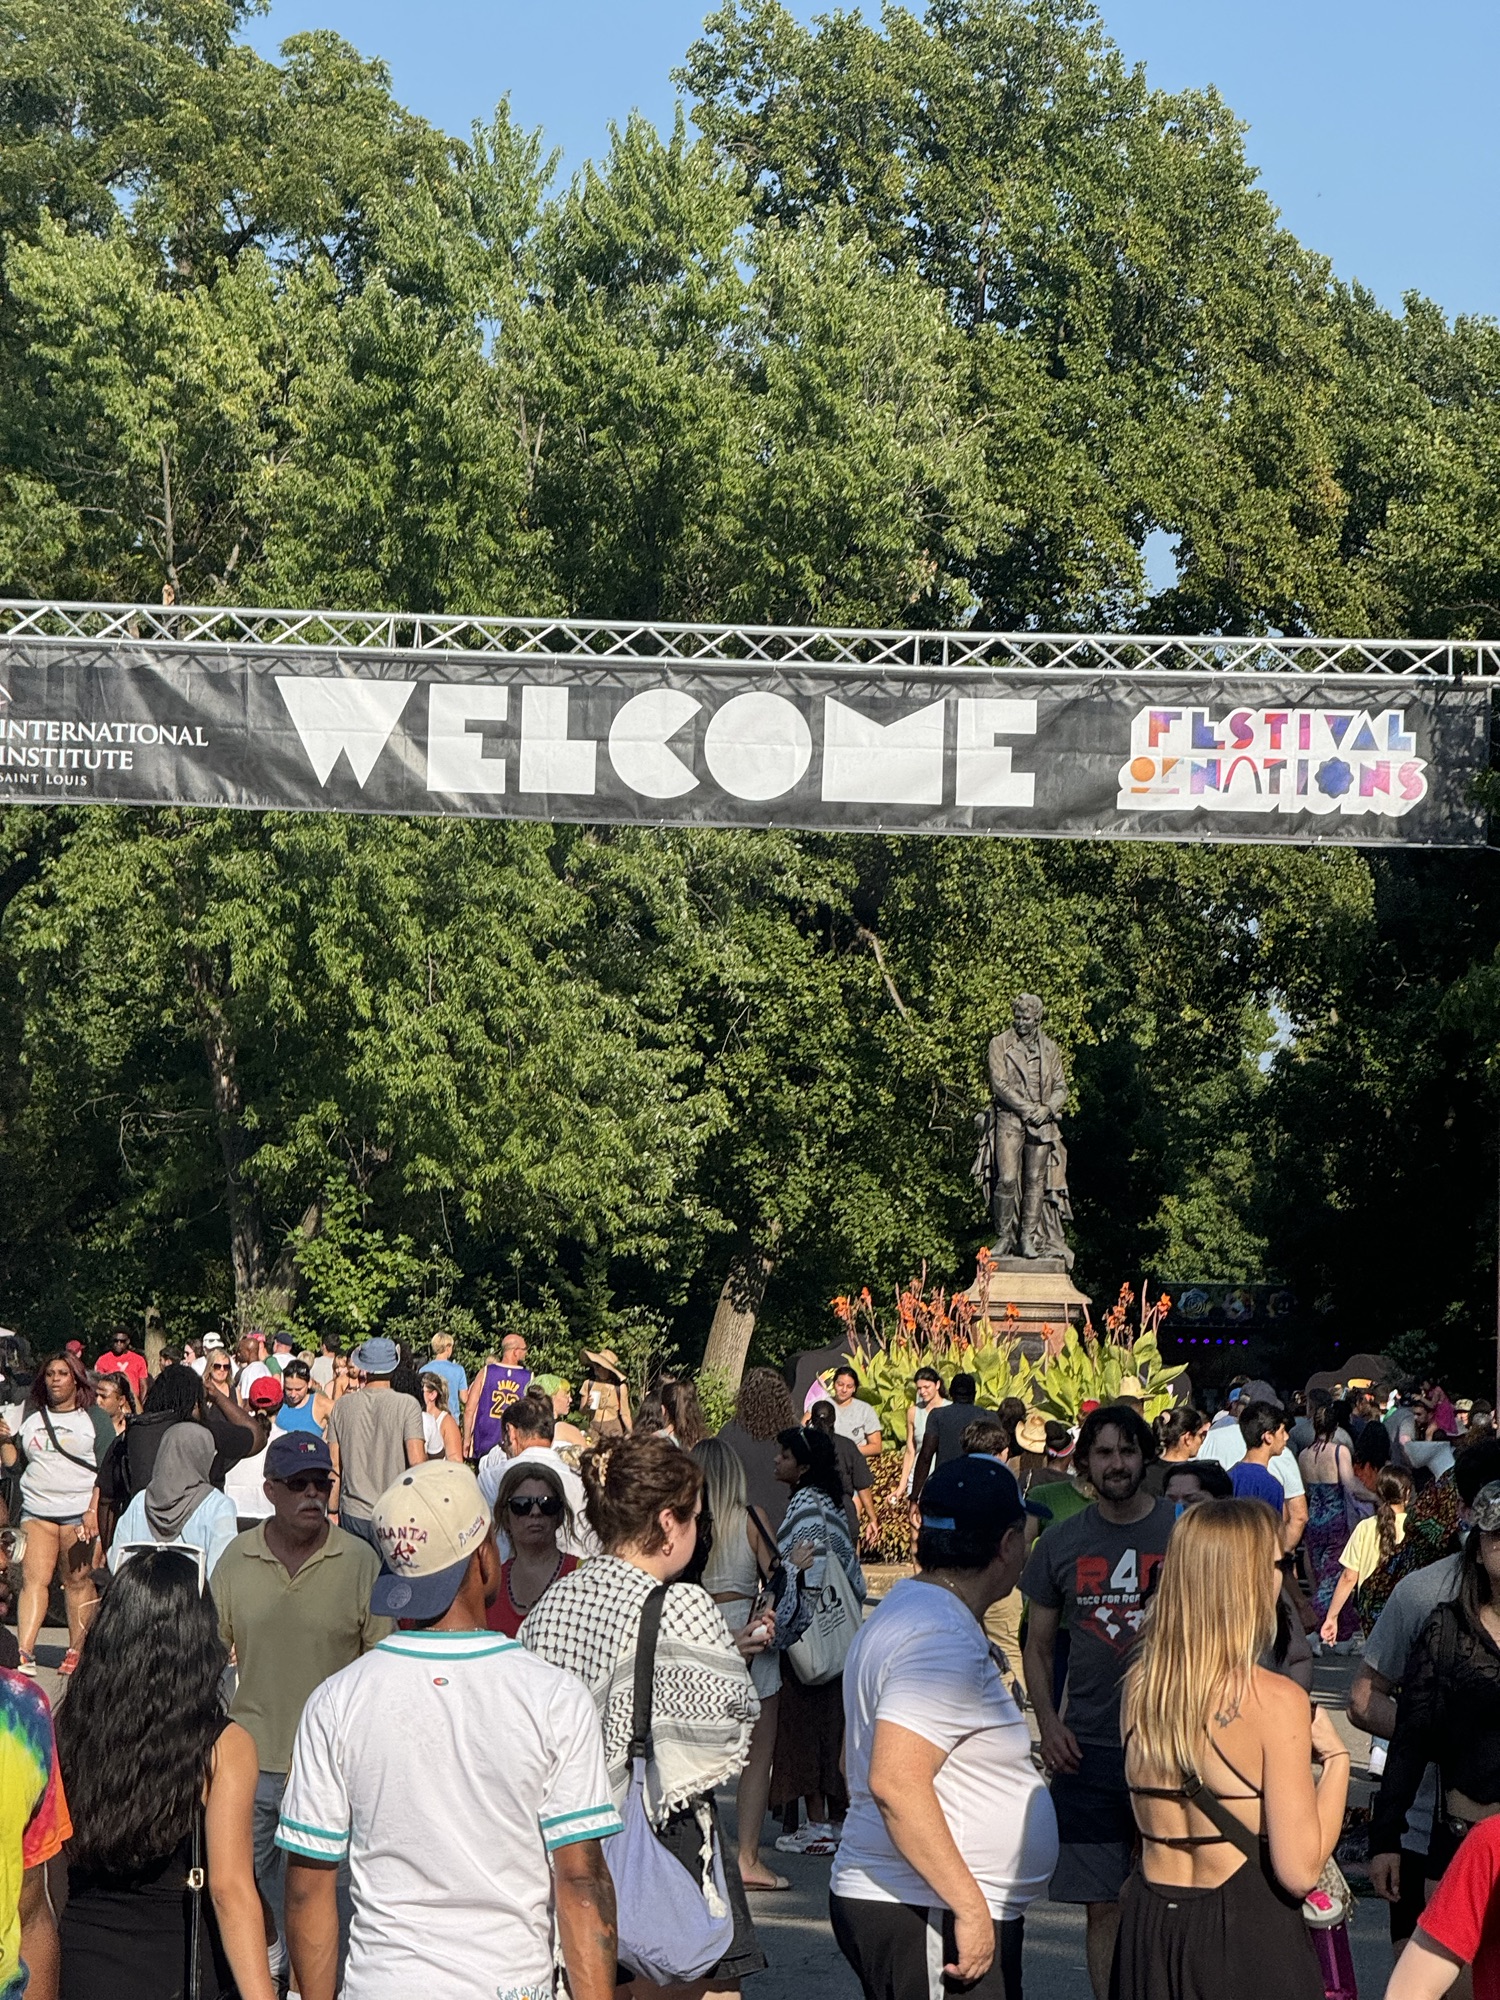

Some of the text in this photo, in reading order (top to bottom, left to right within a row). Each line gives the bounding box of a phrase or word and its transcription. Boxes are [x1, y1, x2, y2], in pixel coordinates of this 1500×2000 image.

[0, 719, 209, 747] INTERNATIONAL
[274, 676, 1037, 807] WELCOME
[1147, 710, 1413, 752] FESTIVAL
[0, 745, 134, 770] INSTITUTE
[0, 772, 88, 786] SAINT LOUIS
[1130, 755, 1425, 800] OF NATIONS
[1101, 1594, 1121, 1604] FOR
